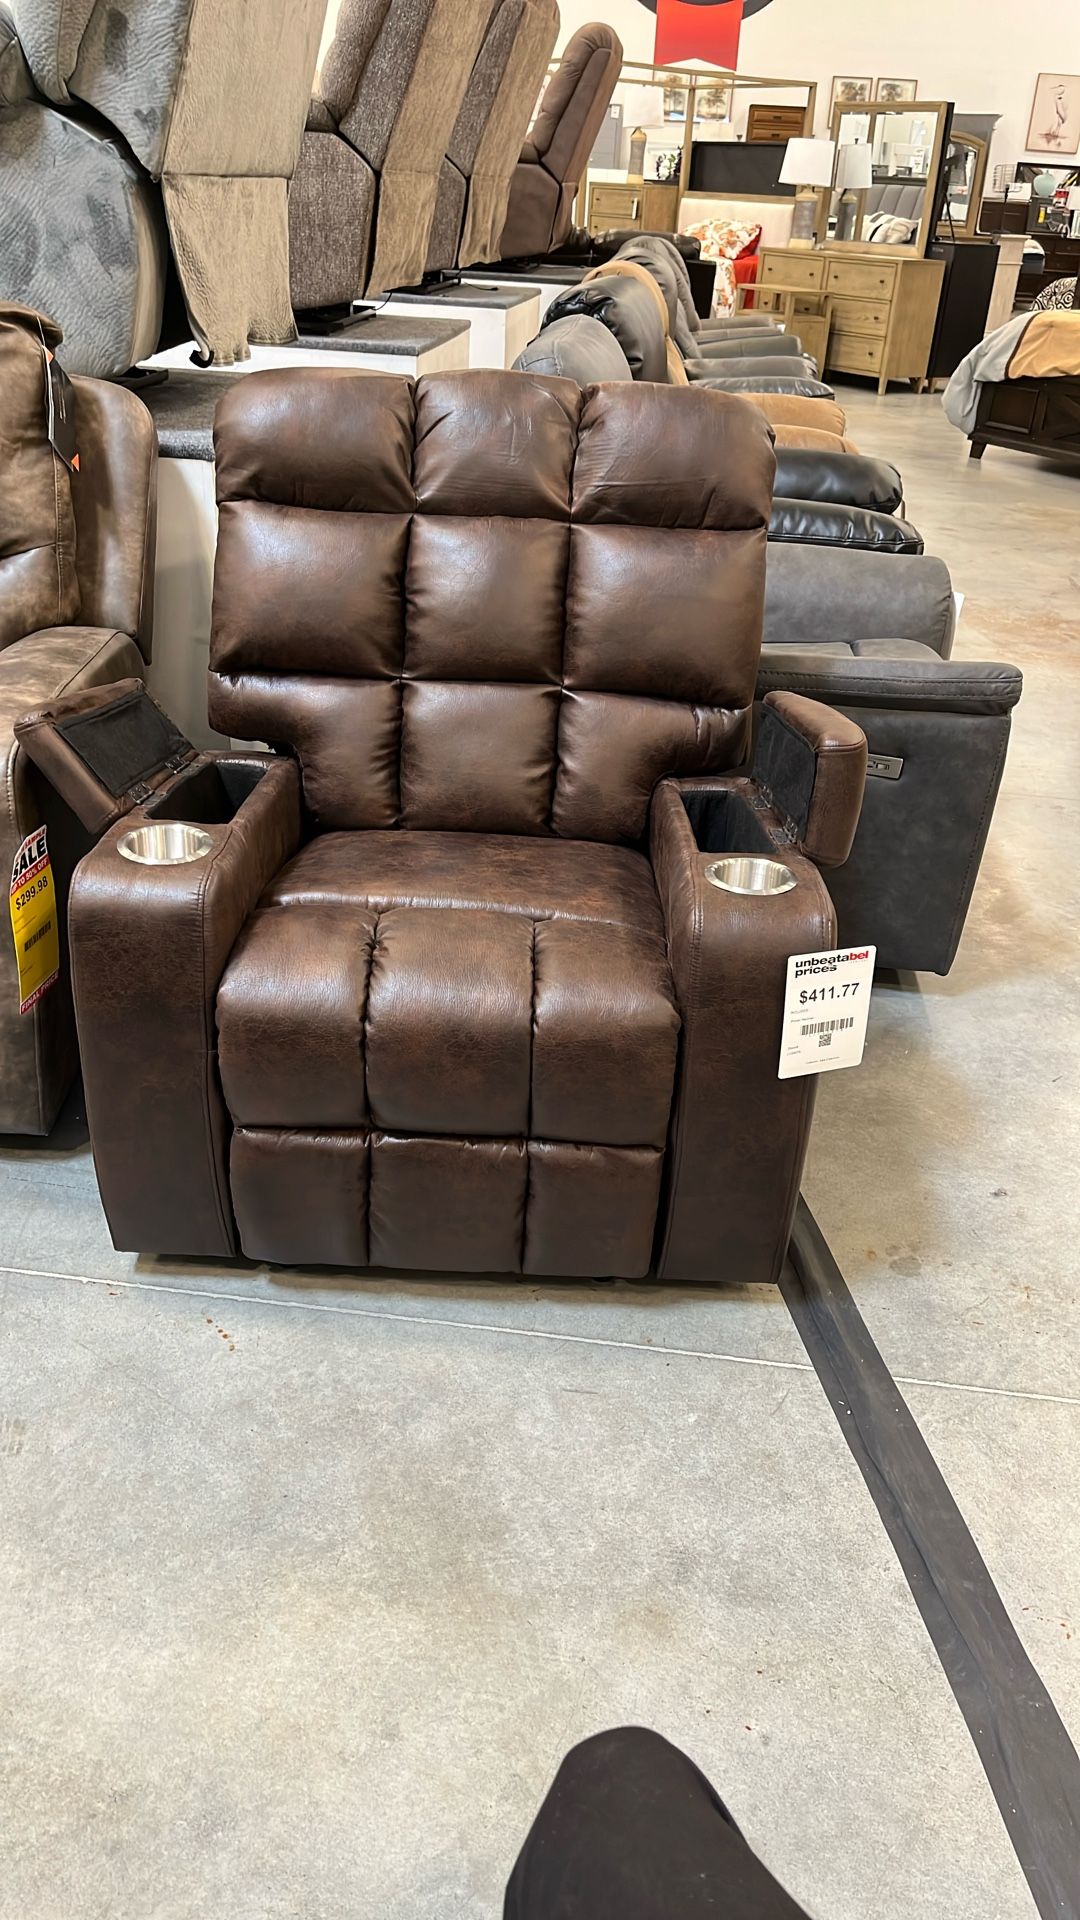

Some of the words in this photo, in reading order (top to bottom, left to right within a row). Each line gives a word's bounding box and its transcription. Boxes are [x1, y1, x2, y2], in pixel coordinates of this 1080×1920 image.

[12, 835, 47, 883] SALE
[17, 876, 26, 887] TO
[38, 859, 48, 870] OFF
[15, 874, 48, 911] $299.98
[795, 950, 869, 968] unbeatabel
[795, 964, 837, 978] prices
[21, 990, 40, 1012] FINAL
[799, 982, 860, 1005] $411.77
